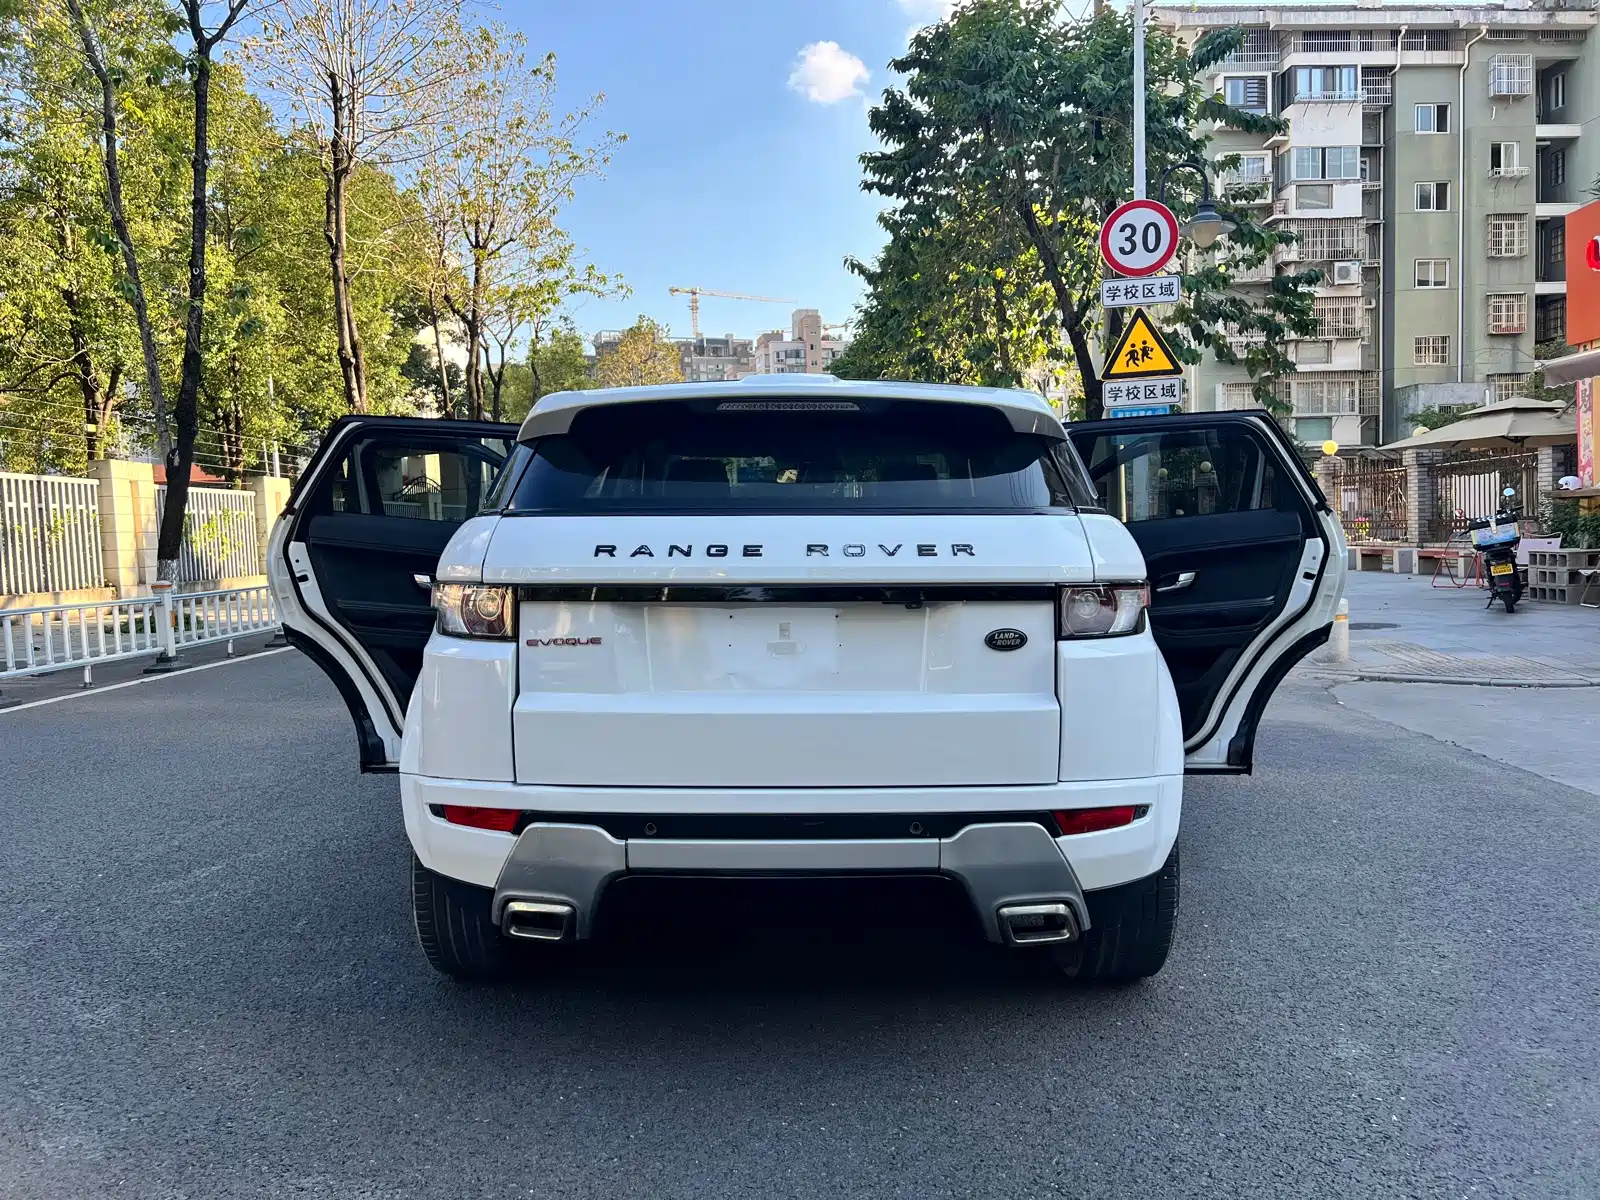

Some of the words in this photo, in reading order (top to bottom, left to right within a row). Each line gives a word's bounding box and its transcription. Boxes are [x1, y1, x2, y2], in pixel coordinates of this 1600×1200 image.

[1118, 221, 1161, 255] 30
[1106, 281, 1175, 301] 学校区域
[1107, 383, 1176, 401] 学校区域
[594, 544, 763, 557] RANGE
[806, 543, 976, 557] ROVER
[526, 637, 602, 647] EVOQUE
